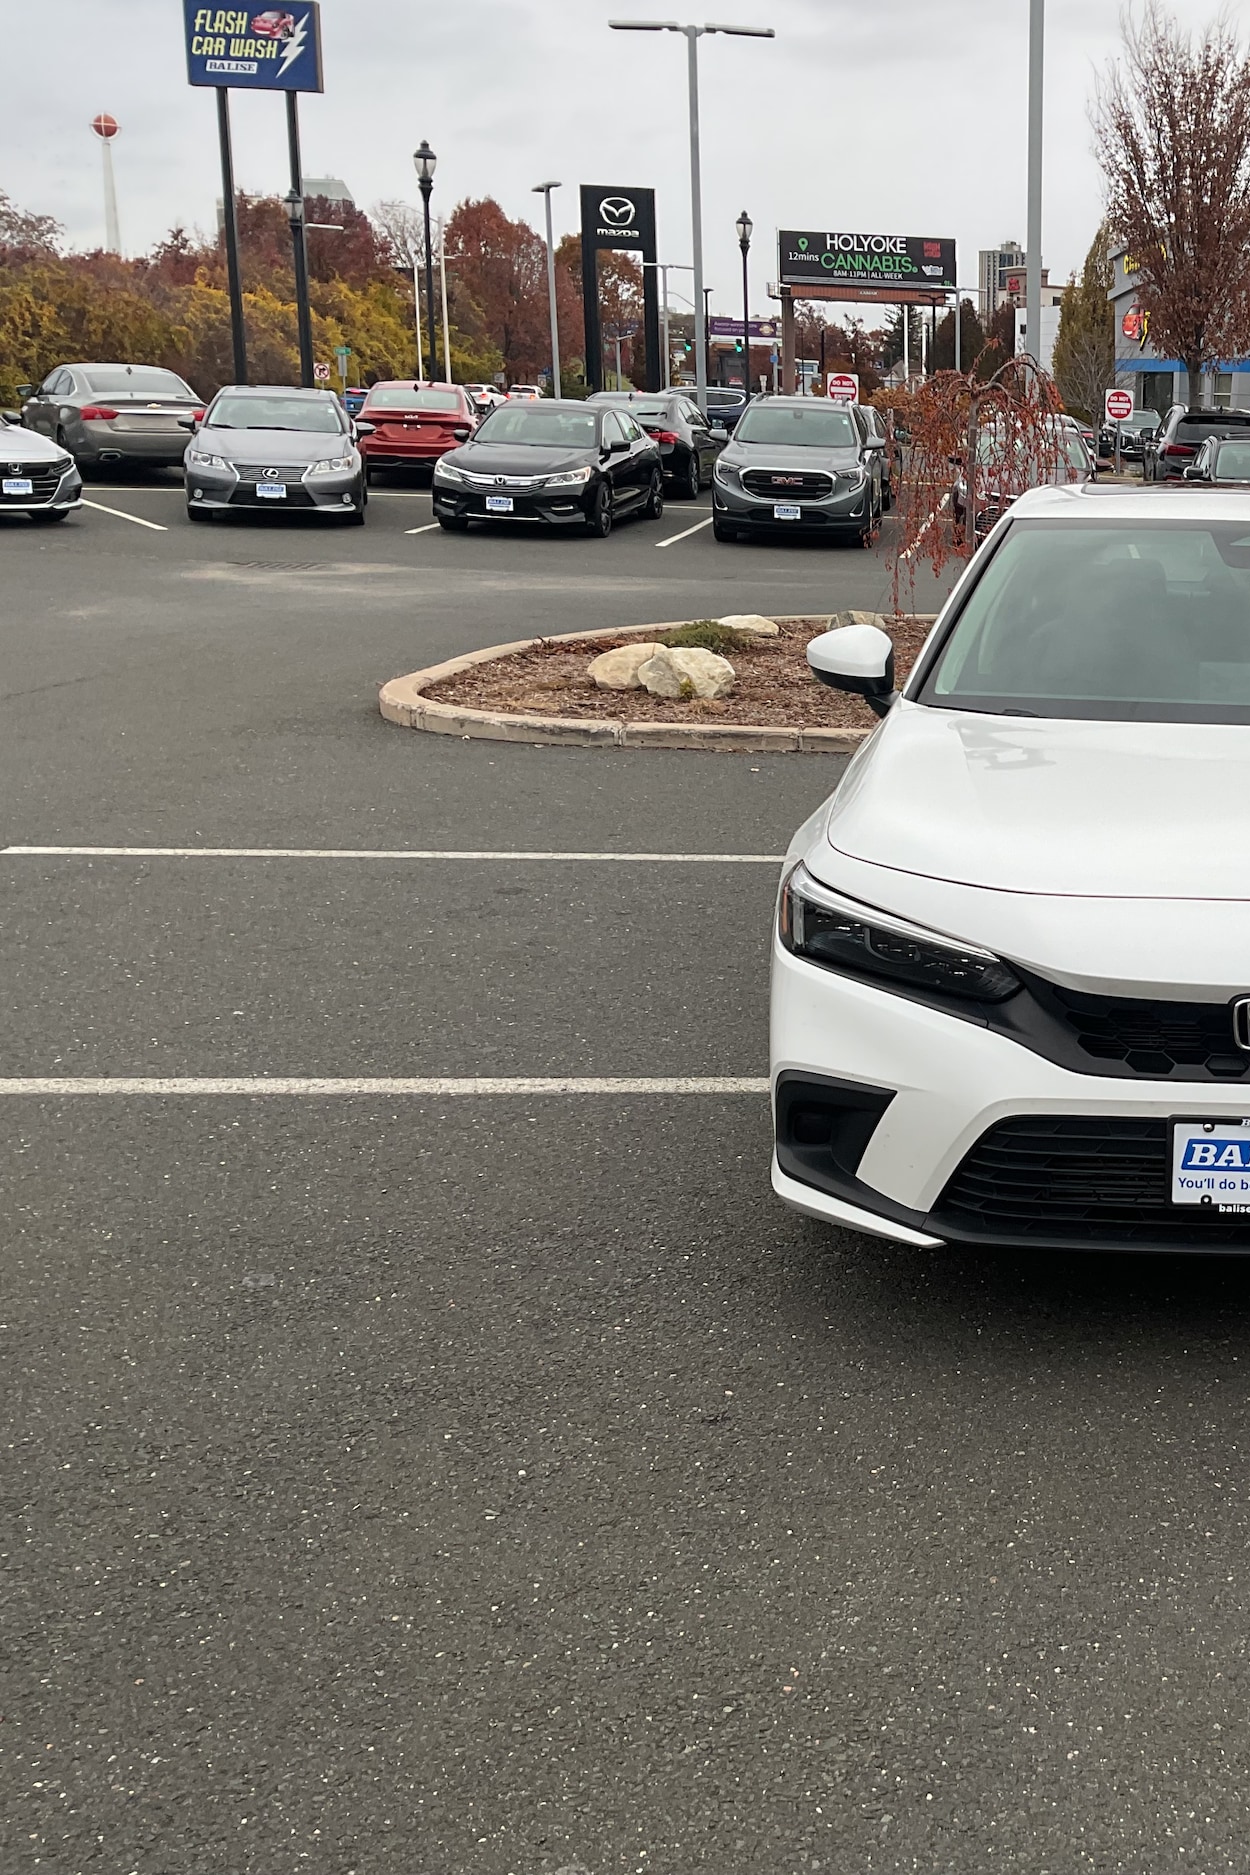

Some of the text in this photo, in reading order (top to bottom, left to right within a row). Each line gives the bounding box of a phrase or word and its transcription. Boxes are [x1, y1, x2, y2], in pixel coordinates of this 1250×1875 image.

[194, 9, 248, 34] FLASH
[192, 36, 278, 59] CAR WASH
[208, 62, 256, 72] BALISE
[826, 233, 907, 254] HOLYOKE
[788, 251, 820, 262] 12mins
[771, 476, 804, 486] GMC
[1219, 1178, 1236, 1190] do
